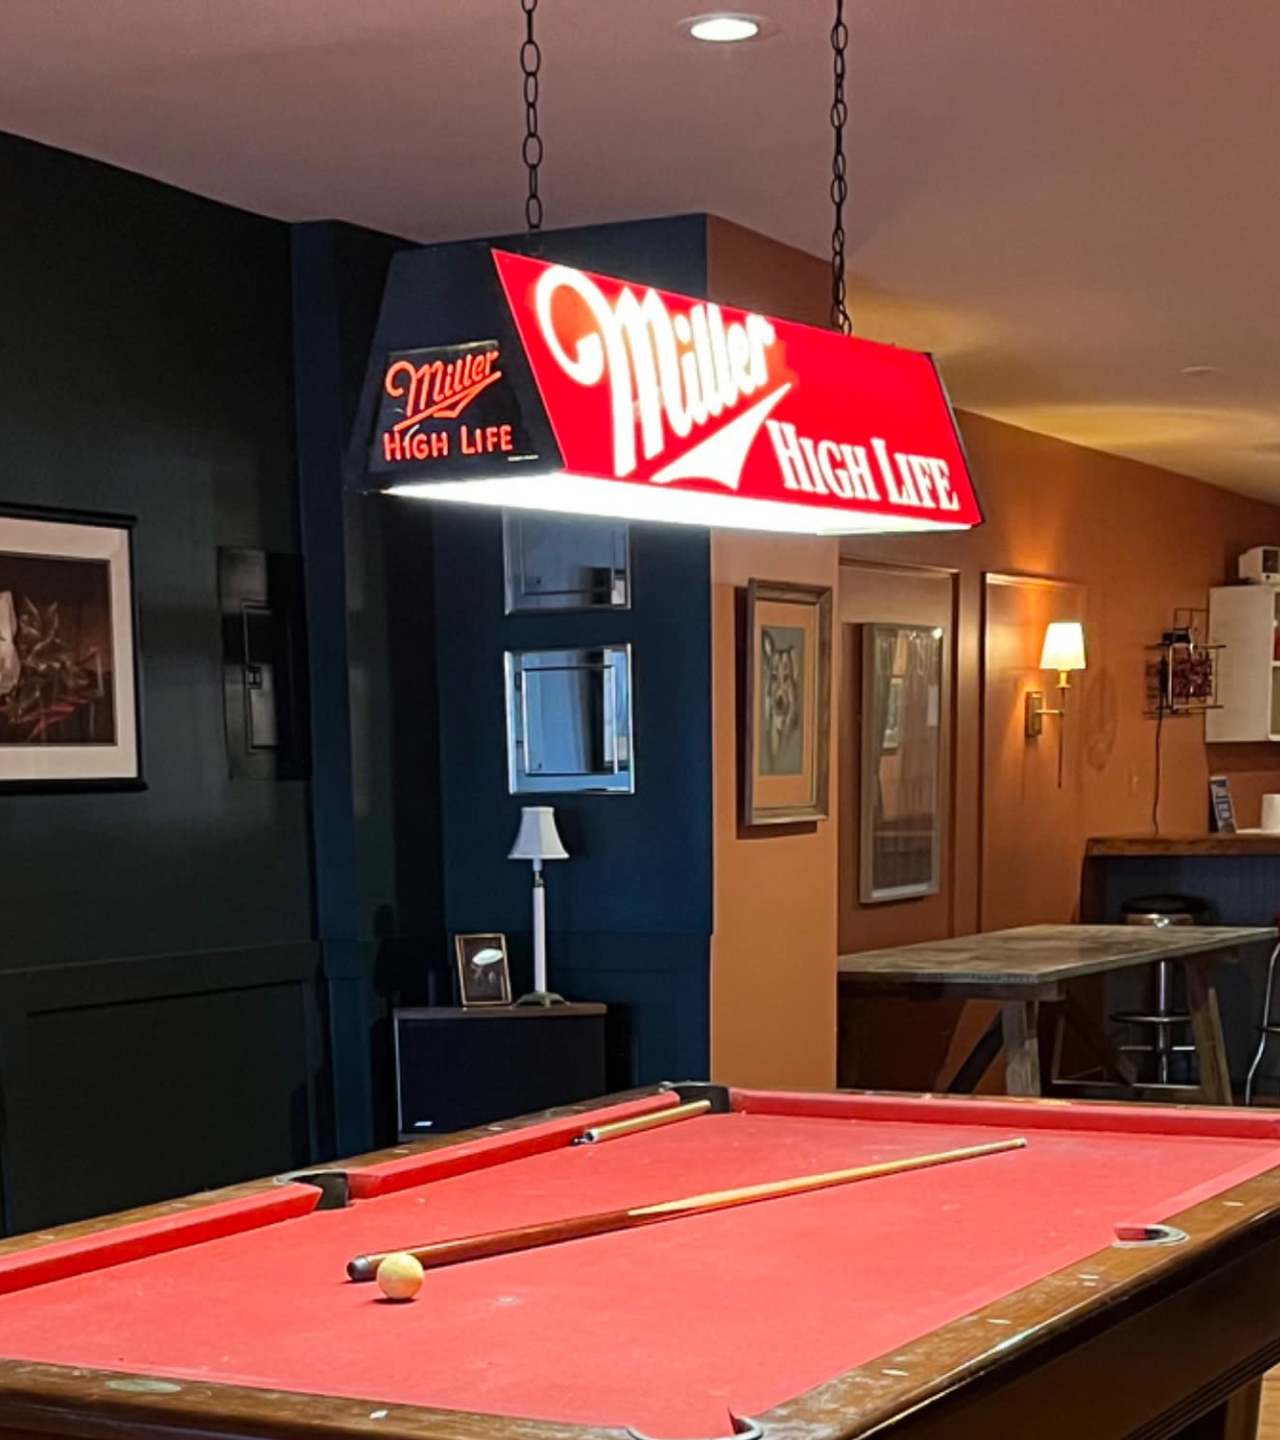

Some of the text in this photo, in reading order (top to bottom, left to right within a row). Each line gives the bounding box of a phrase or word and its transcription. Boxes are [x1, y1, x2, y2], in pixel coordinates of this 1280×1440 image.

[385, 350, 499, 417] Miller
[536, 264, 775, 477] Miller
[384, 424, 513, 460] HIGH LIFE
[766, 419, 961, 511] HIGH LIFE
